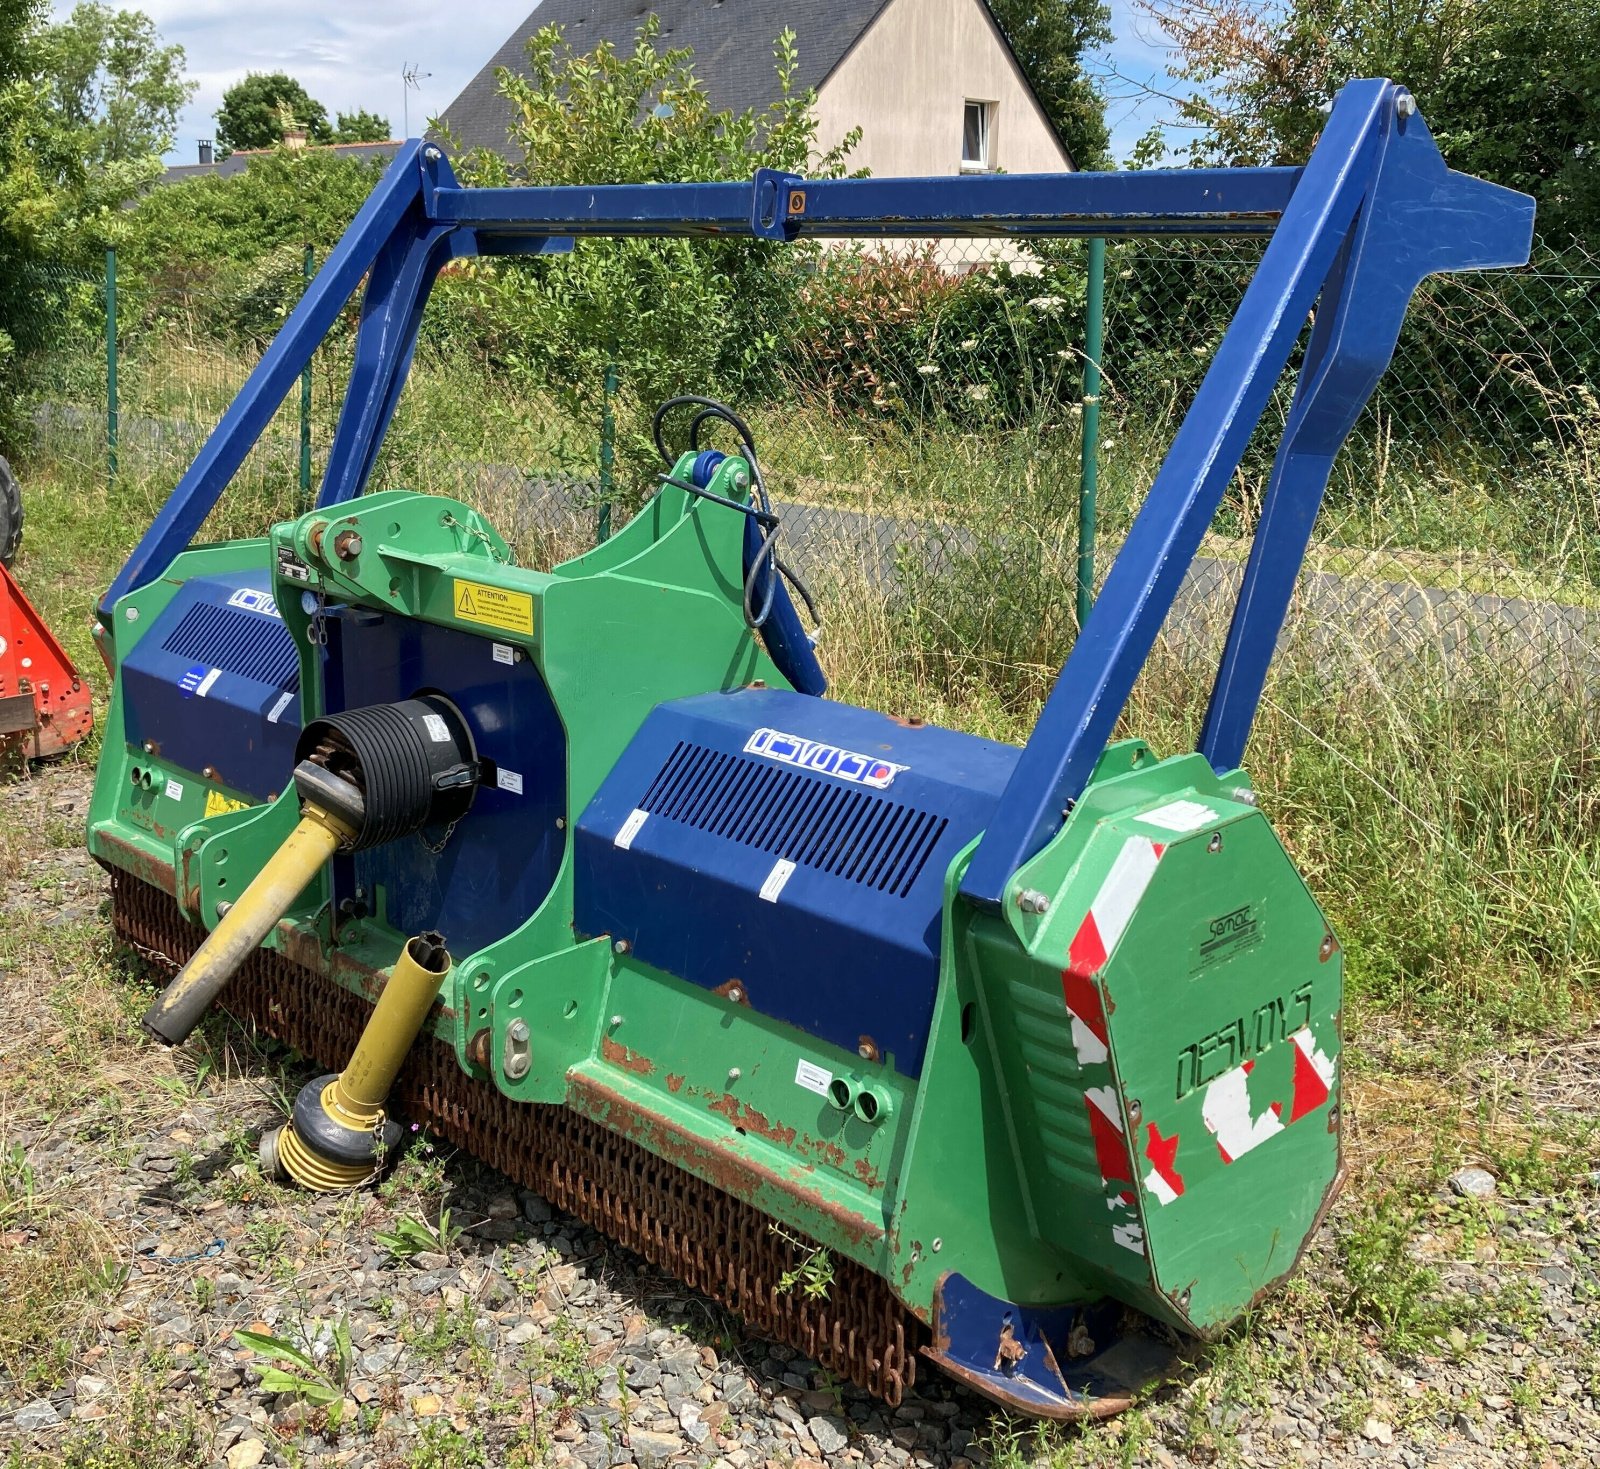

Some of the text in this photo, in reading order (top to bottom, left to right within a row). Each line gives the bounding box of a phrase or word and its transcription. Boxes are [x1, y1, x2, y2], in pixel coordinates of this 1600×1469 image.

[477, 589, 508, 602] ATTENTION
[746, 728, 873, 780] DESVOYS
[1176, 980, 1312, 1102] DESVOYS
